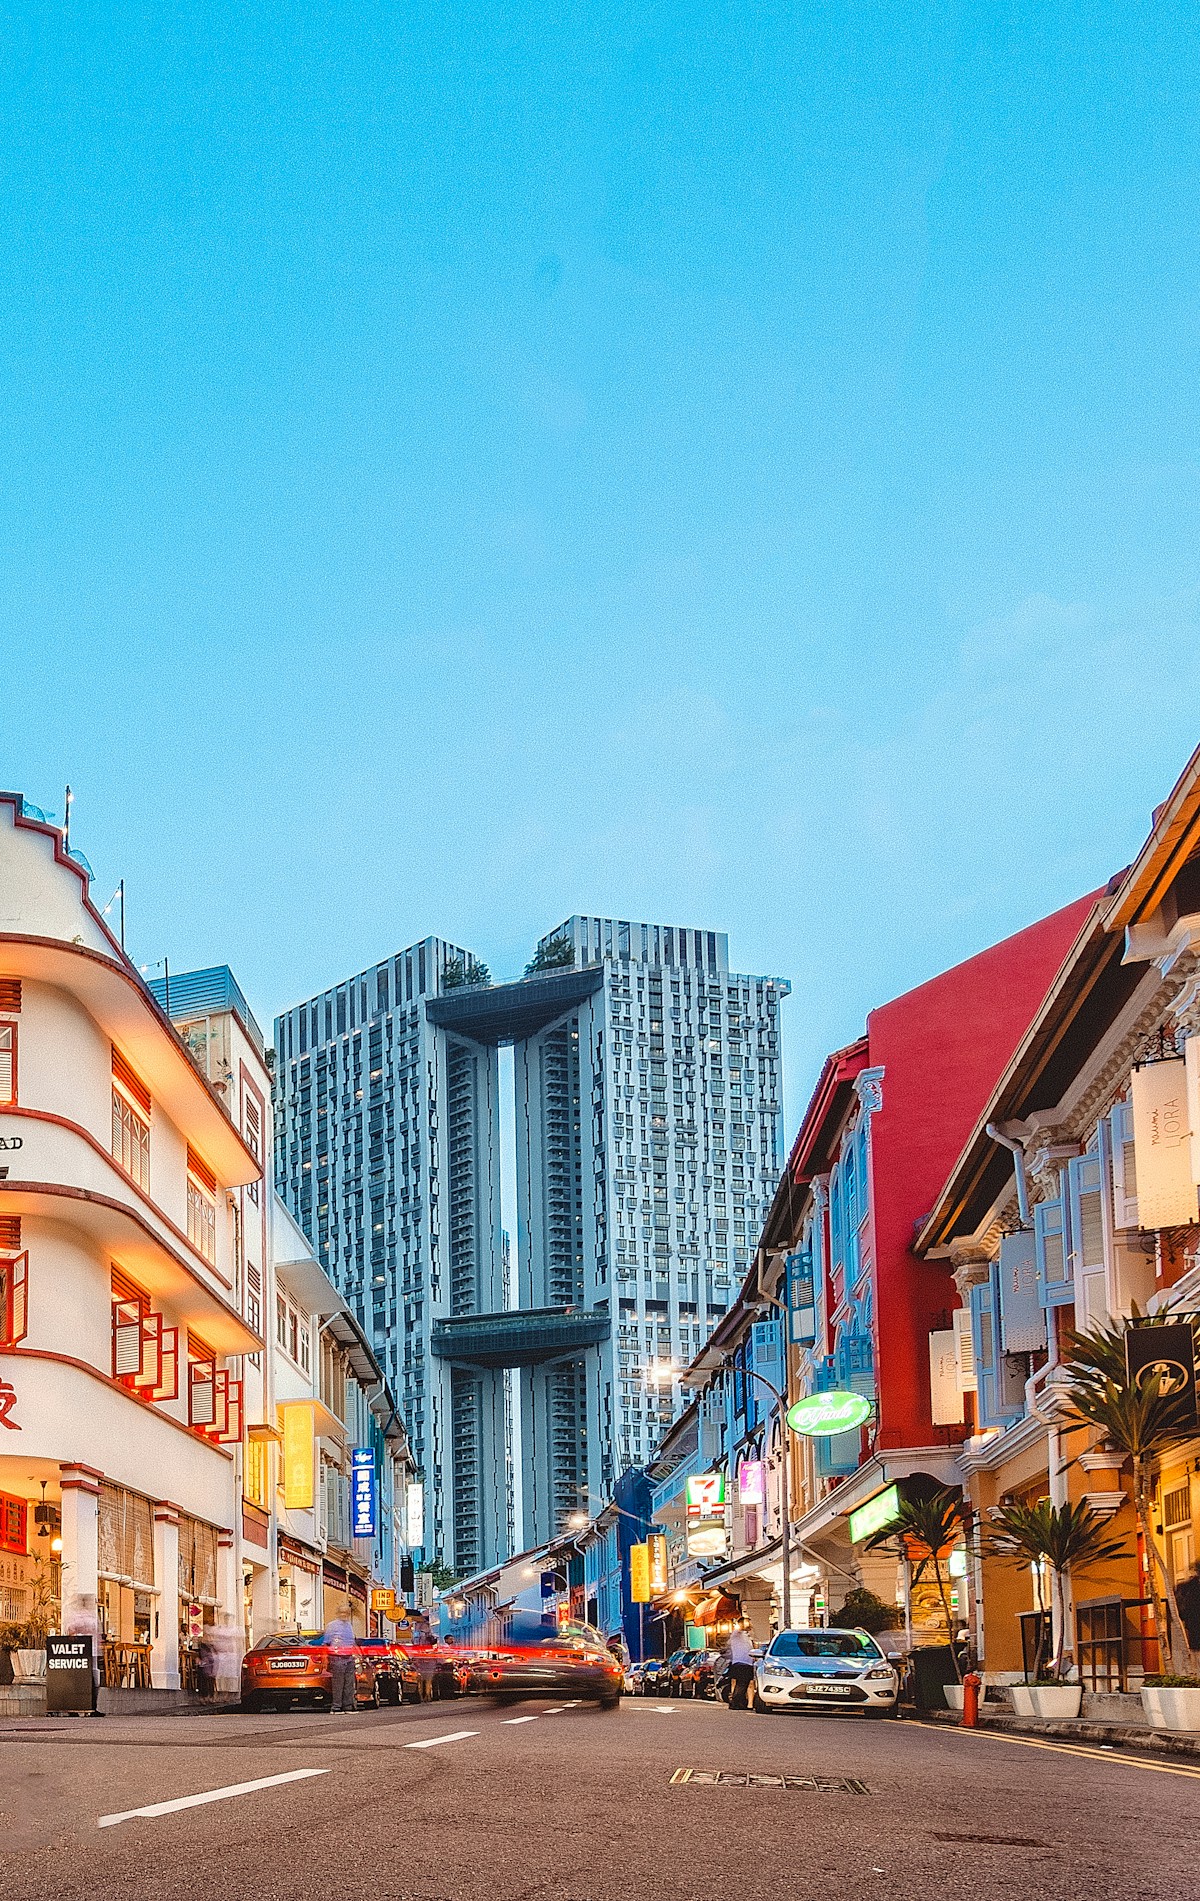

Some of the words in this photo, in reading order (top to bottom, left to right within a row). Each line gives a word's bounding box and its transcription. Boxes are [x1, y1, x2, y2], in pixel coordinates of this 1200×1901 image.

[1163, 1097, 1181, 1149] LIORA
[1022, 1258, 1035, 1297] LIORA
[51, 1643, 86, 1655] VALET
[48, 1658, 89, 1669] SERVICE
[806, 1685, 850, 1693] SJZ7435C
